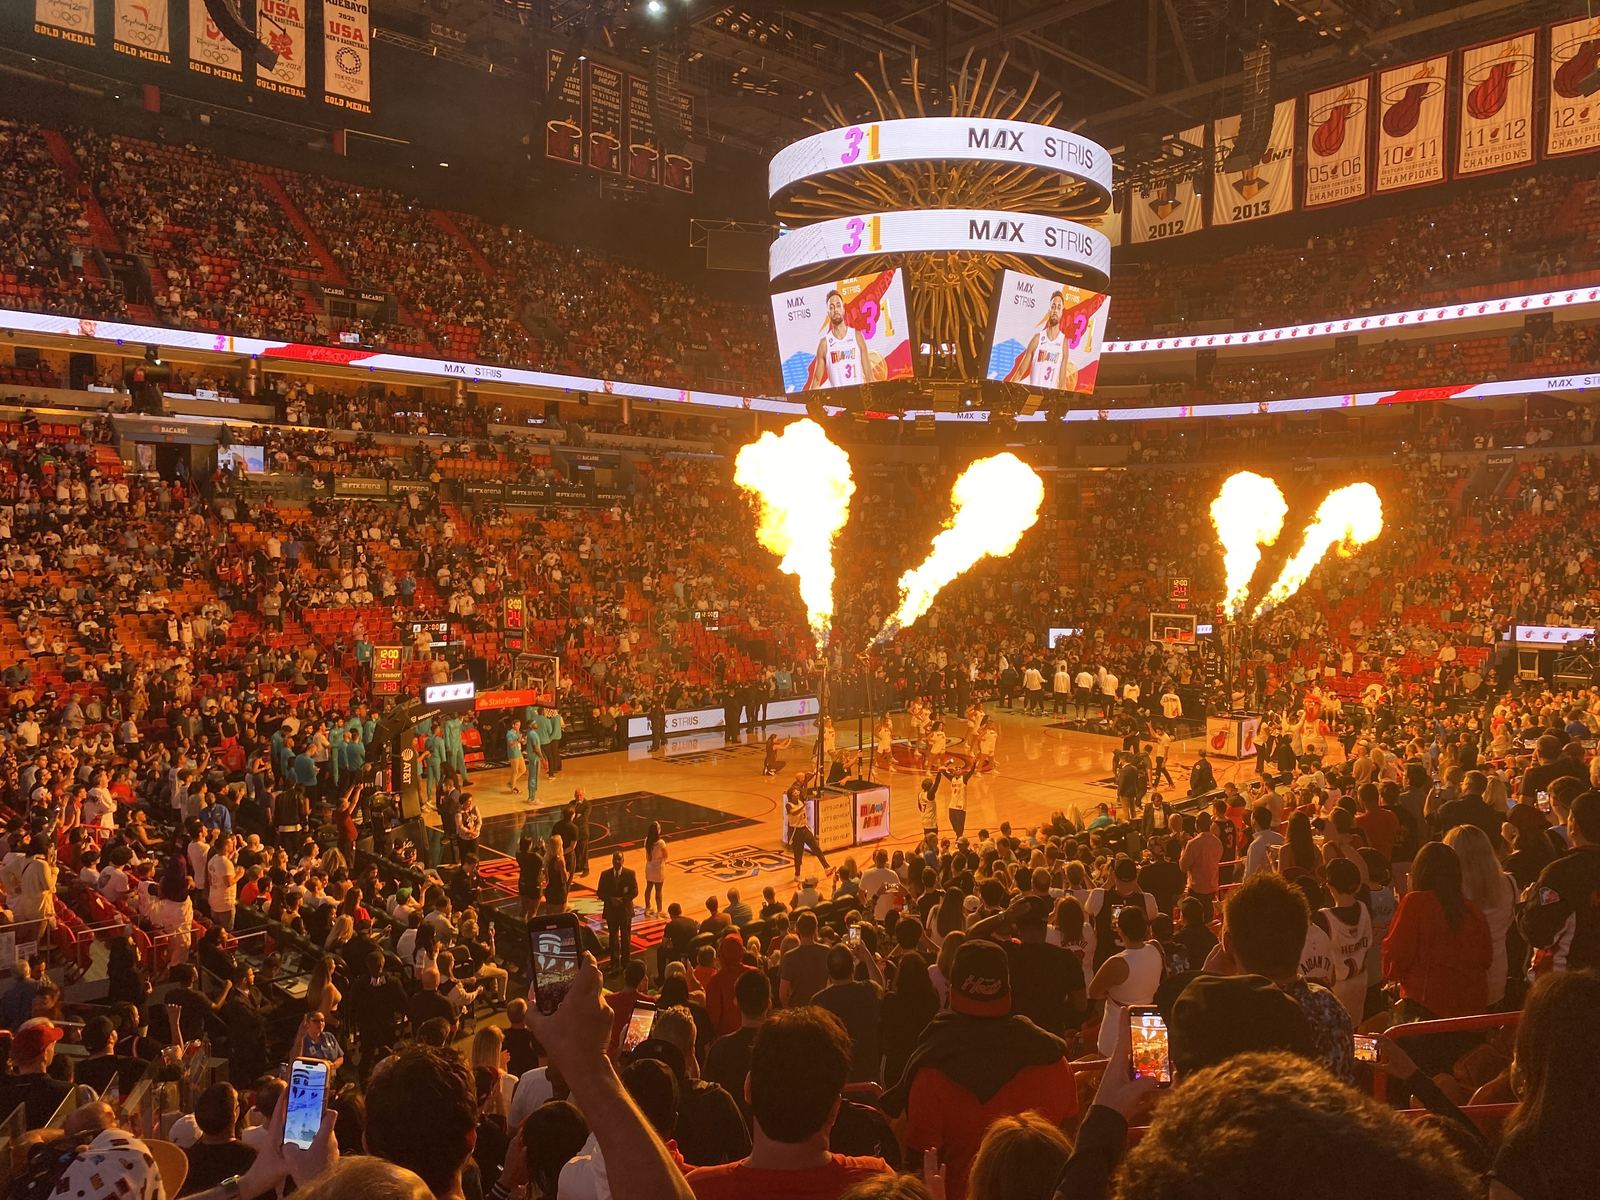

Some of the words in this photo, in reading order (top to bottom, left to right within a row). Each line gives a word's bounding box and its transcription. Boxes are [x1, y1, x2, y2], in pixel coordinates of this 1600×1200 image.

[263, 0, 299, 21] USA
[35, 23, 59, 38] GOLD
[62, 30, 96, 46] MEDAL
[329, 20, 364, 42] USA
[113, 42, 137, 57] GOLD
[139, 49, 171, 64] MEDAL
[189, 61, 211, 75] GOLD
[213, 68, 243, 82] MEDAL
[256, 79, 276, 91] GOLD
[278, 85, 306, 98] MEDAL
[325, 95, 344, 107] GOLD
[346, 100, 371, 113] MEDAL
[1553, 107, 1575, 129] 12
[1465, 128, 1484, 149] 11
[1504, 119, 1526, 141] 12
[841, 124, 881, 164] 31
[968, 127, 1024, 152] MAX
[1044, 136, 1093, 169] STRUS
[1383, 146, 1404, 167] 10
[1420, 139, 1436, 159] 11
[1463, 149, 1527, 169] CHAMPIONS
[1310, 165, 1328, 183] 05
[1341, 156, 1361, 177] 06
[1380, 167, 1438, 186] CHAMPIONS
[1310, 183, 1362, 202] CHAMPIONS
[1233, 200, 1270, 221] 2013
[842, 216, 882, 255] 31
[969, 219, 1024, 242] MAX
[1044, 226, 1093, 256] STRUS
[1149, 219, 1184, 240] 2012
[1017, 281, 1034, 294] MAX
[786, 296, 805, 308] MAX
[1014, 295, 1036, 309] STRUS
[788, 308, 812, 321] STRUS
[861, 299, 895, 340] 31
[1068, 313, 1095, 353] 31
[444, 363, 466, 375] MAX
[475, 367, 502, 379] STRUS
[1547, 378, 1573, 389] MAX
[957, 412, 974, 420] MAX
[1173, 585, 1187, 597] 24
[507, 609, 521, 628] 24
[380, 649, 399, 659] 12:00
[380, 659, 395, 669] 24
[671, 715, 699, 728] STRUS
[403, 762, 412, 785] AT&T
